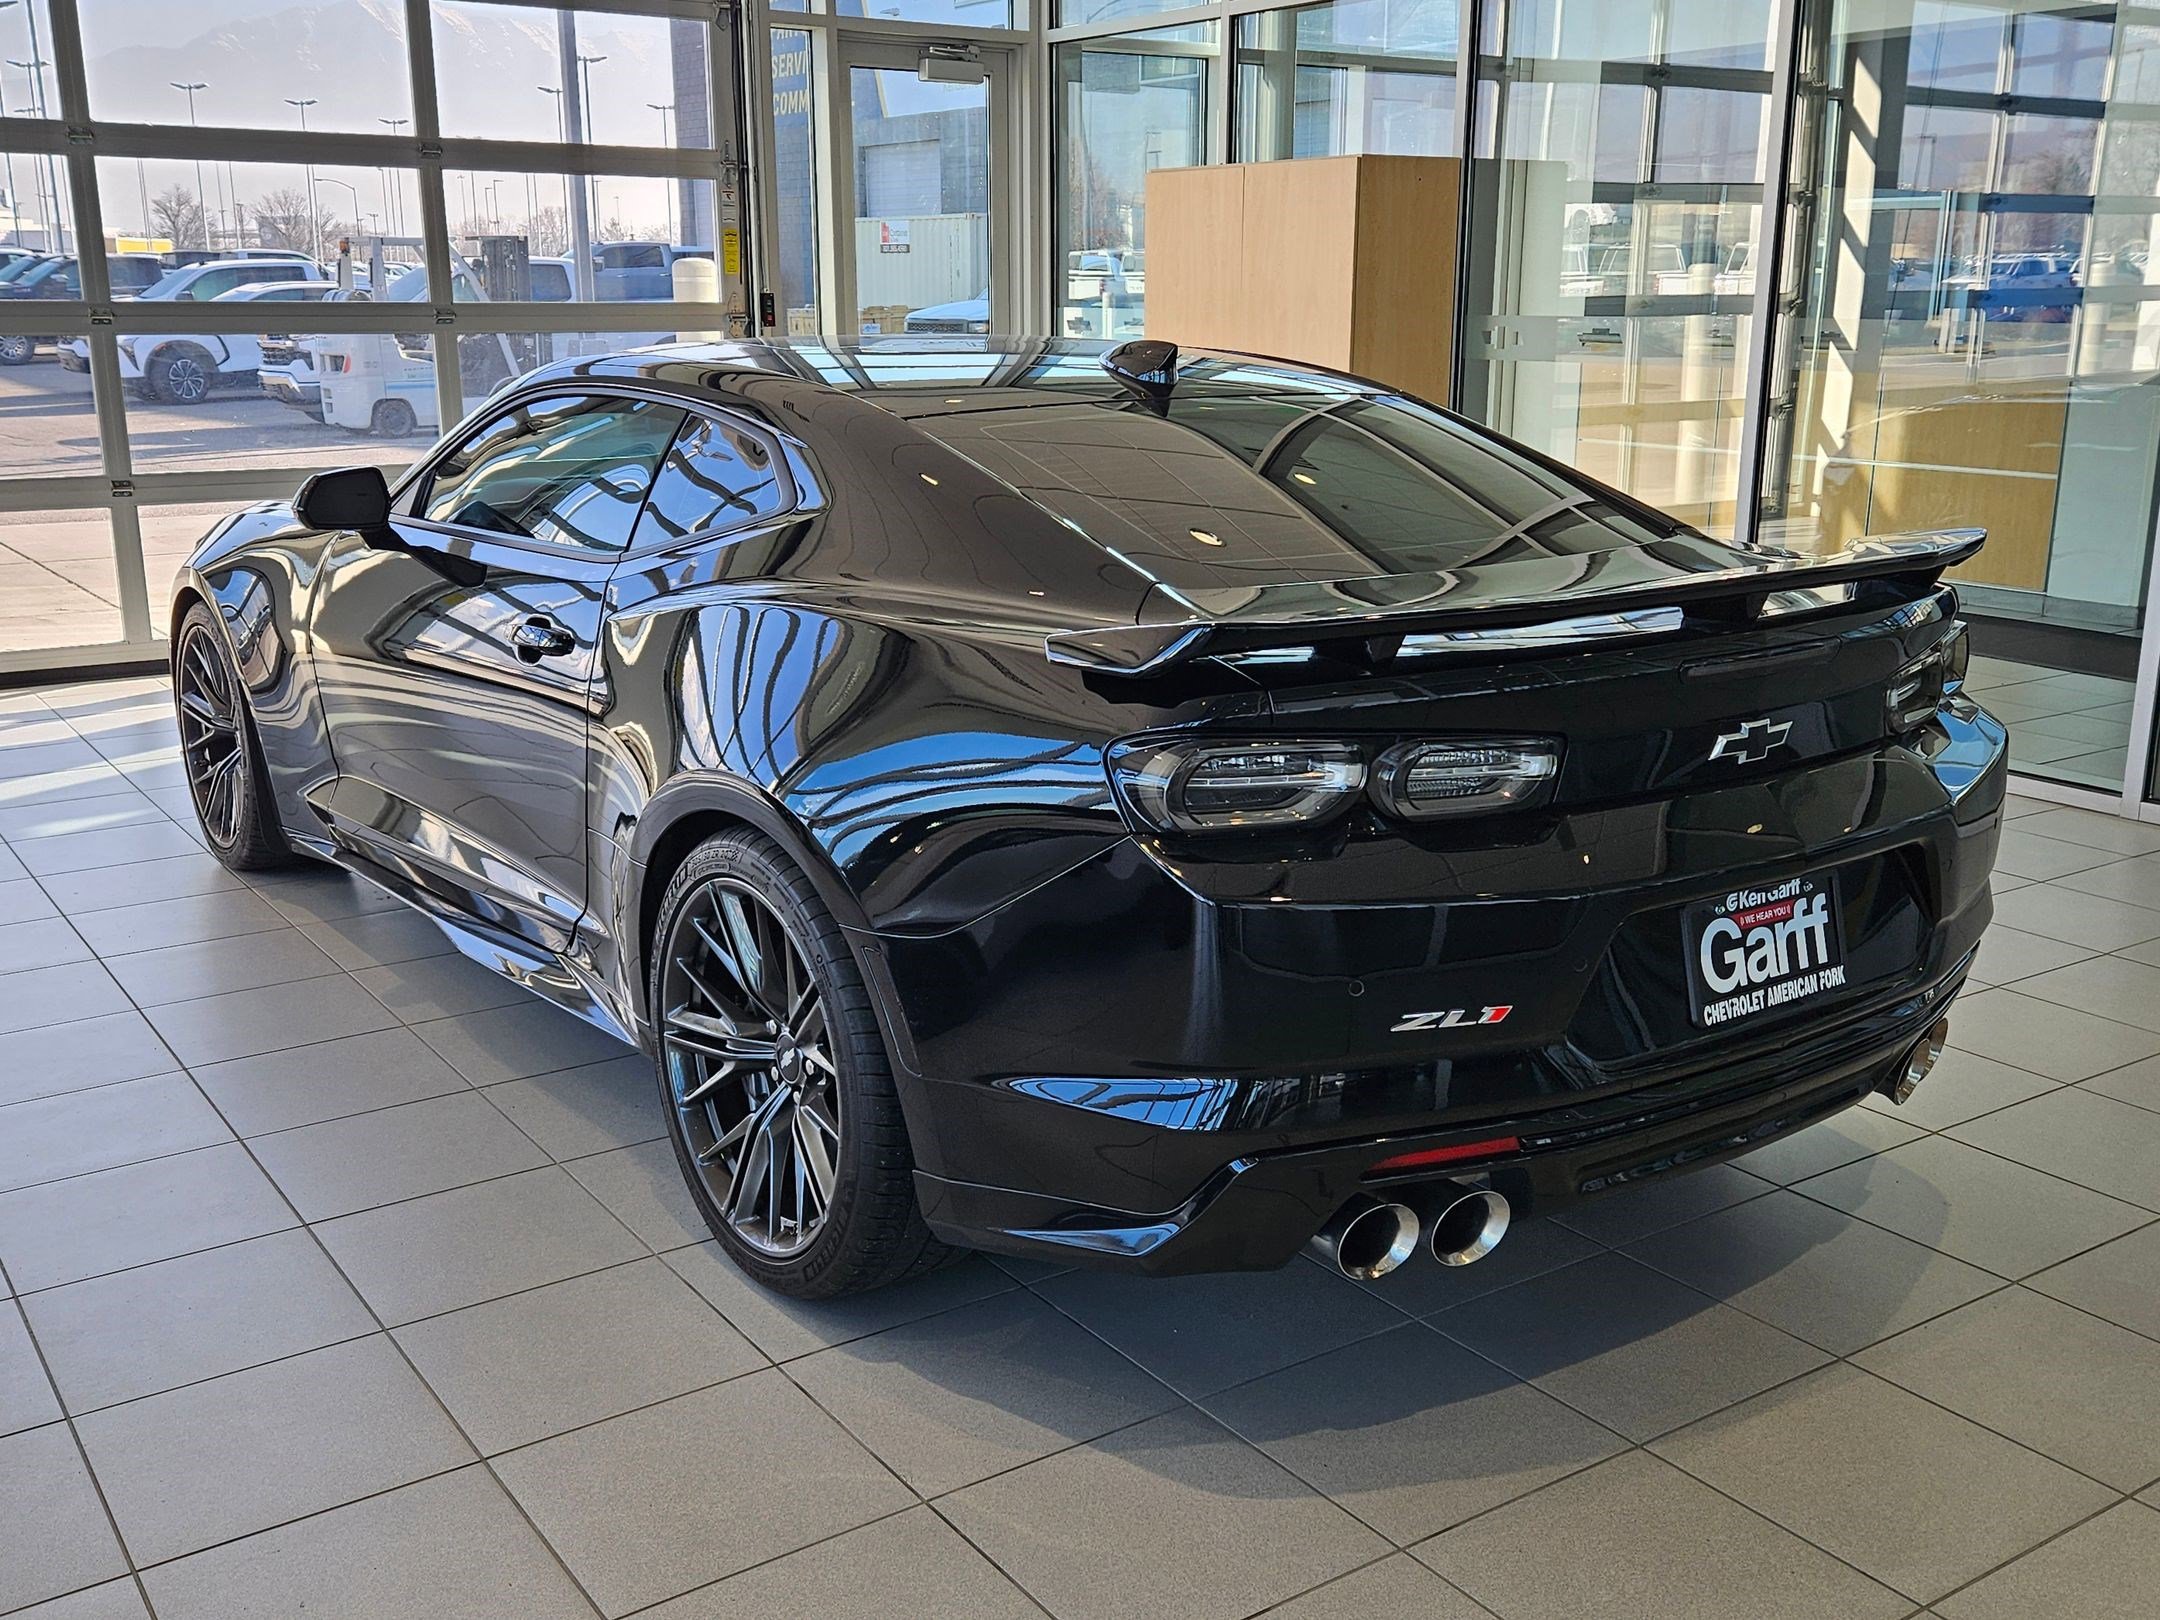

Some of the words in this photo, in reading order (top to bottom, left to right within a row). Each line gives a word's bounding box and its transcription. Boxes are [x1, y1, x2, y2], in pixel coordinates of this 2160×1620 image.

[1745, 914, 1756, 924] WE
[1756, 908, 1774, 922] HEAR
[1773, 906, 1786, 918] YOU
[1701, 893, 1828, 994] Garff
[1704, 989, 1765, 1026] CHEVROLET
[1767, 974, 1818, 1008] AMERICAN
[1819, 965, 1846, 991] FORK
[1390, 1005, 1513, 1032] ZL1
